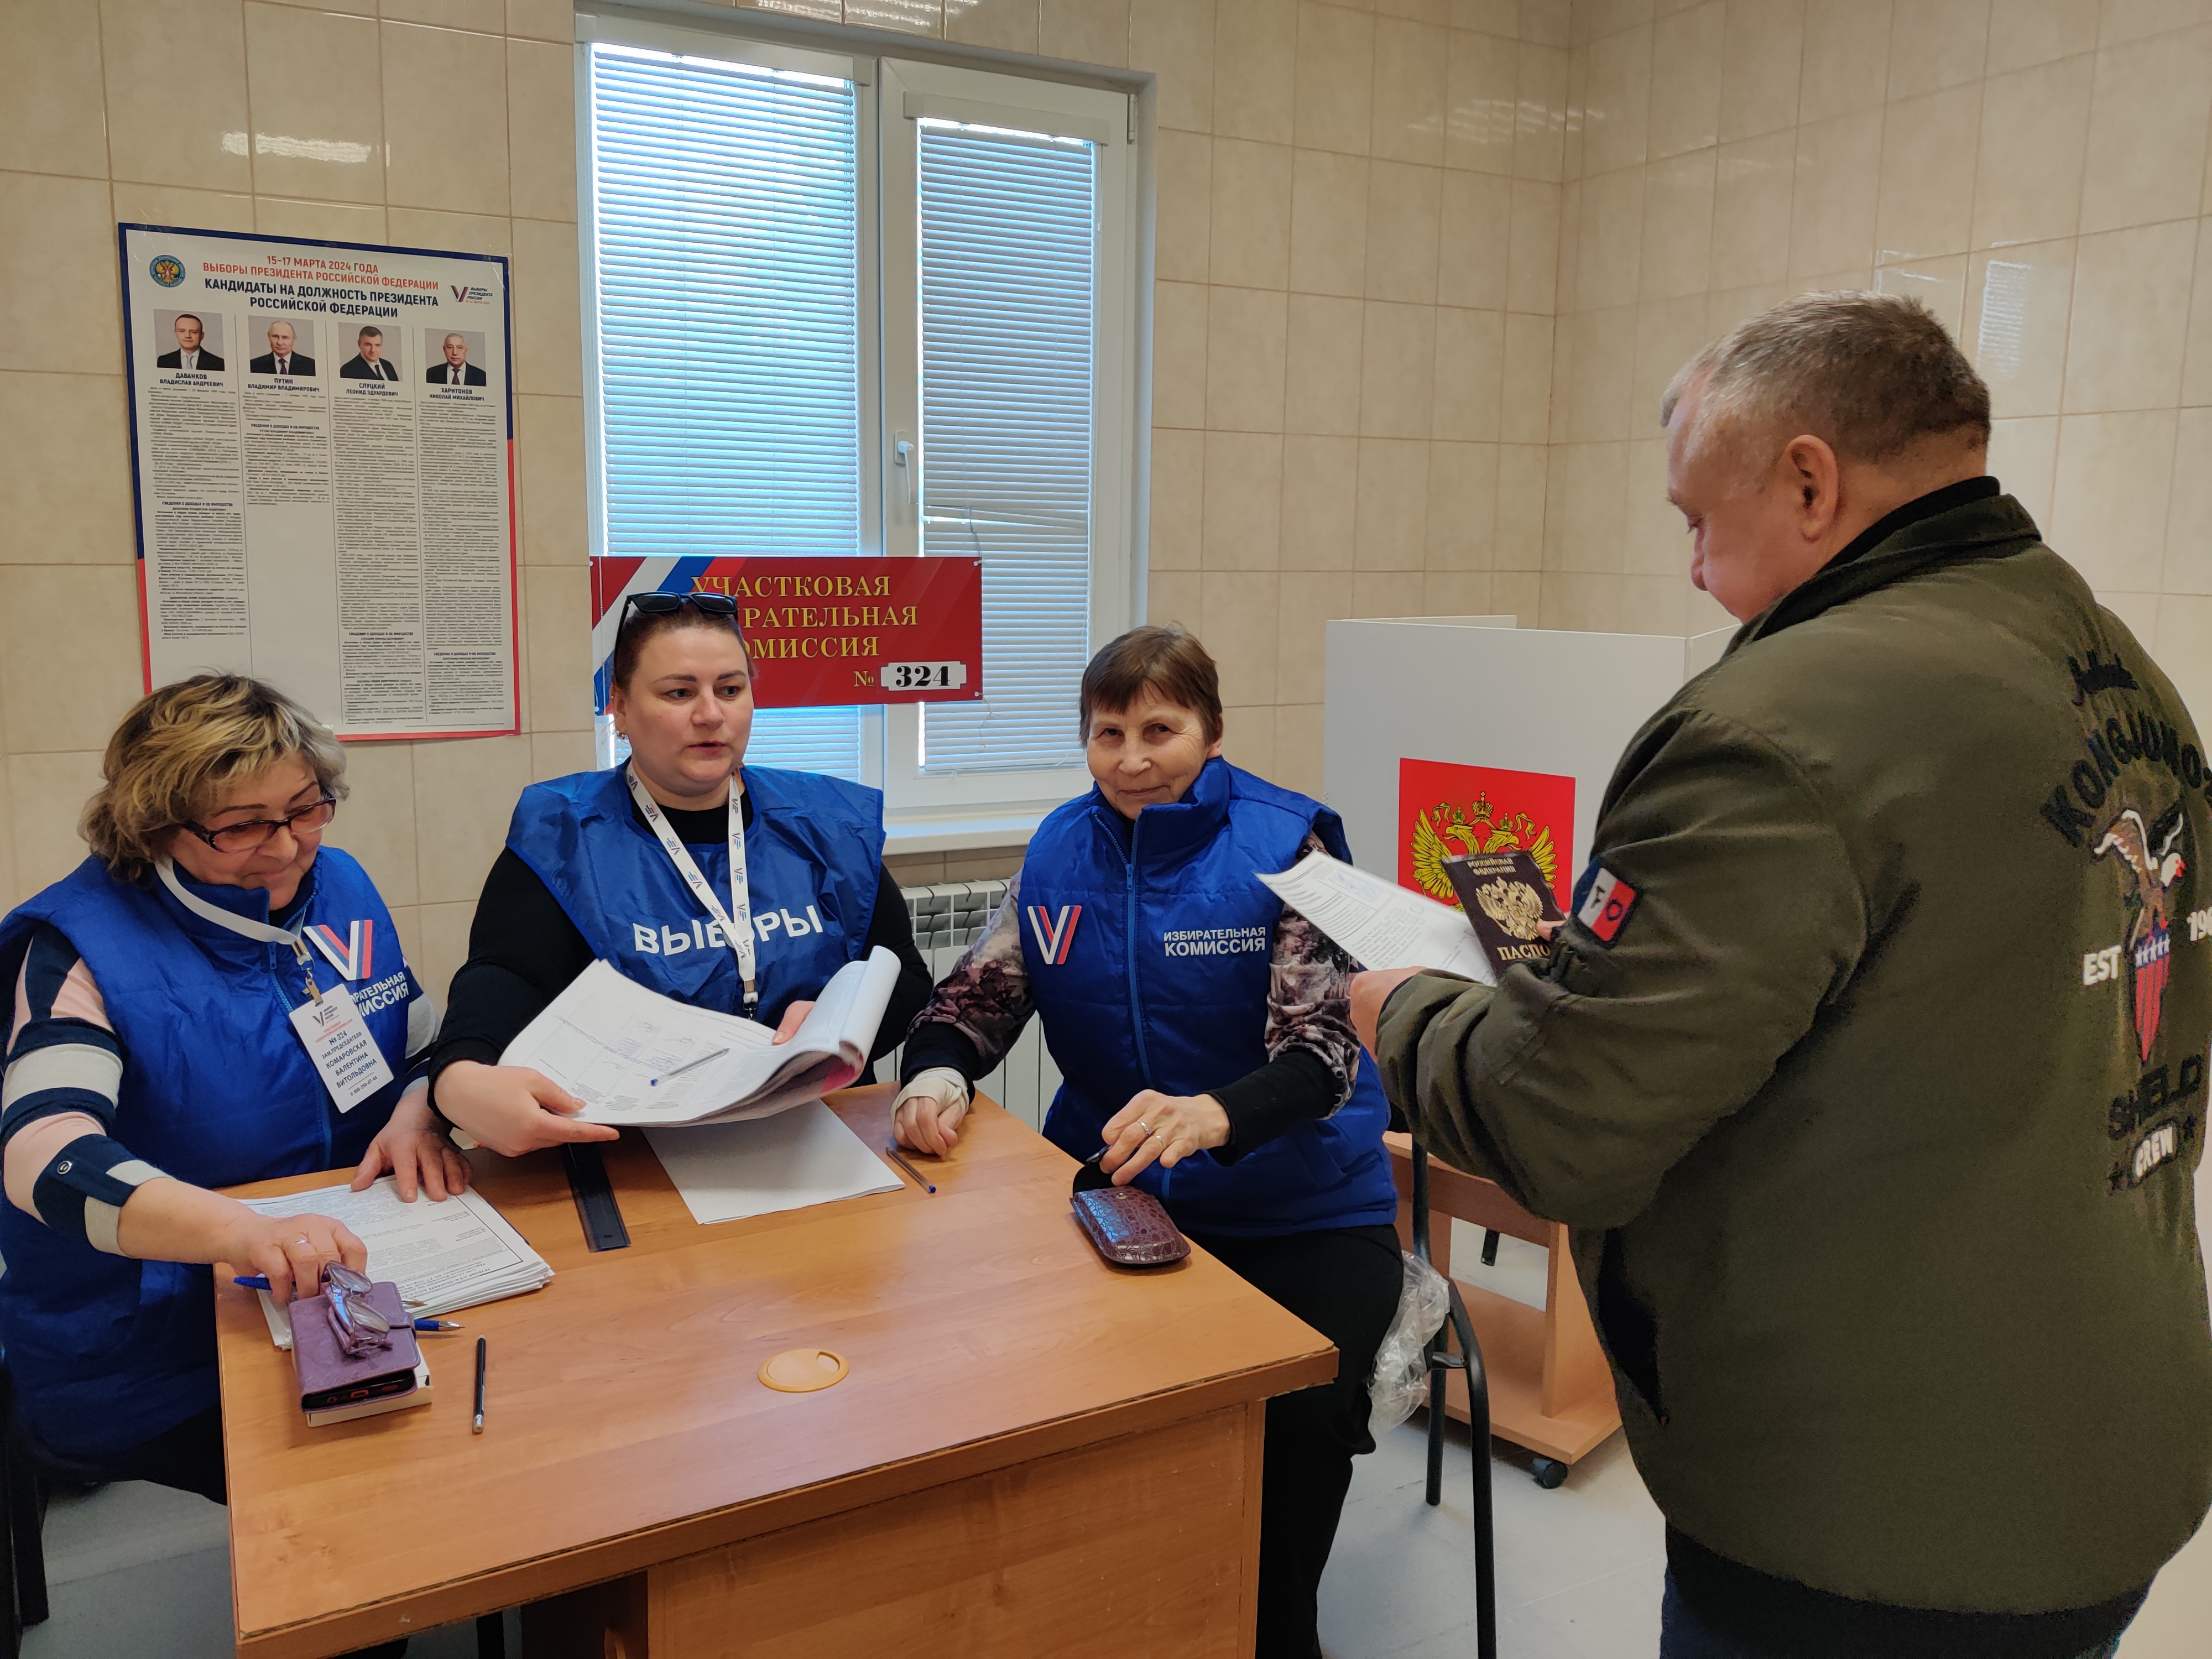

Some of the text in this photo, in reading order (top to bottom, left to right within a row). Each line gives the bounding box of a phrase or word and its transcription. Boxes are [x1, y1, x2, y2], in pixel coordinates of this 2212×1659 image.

[203, 262, 439, 290] ВЫБОРЫ ПРЕЗИДЕНТА РОССИЙСКОЙ ФЕДЕРАЦИИ
[294, 258, 326, 269] МАРТА
[328, 260, 351, 271] 2024
[354, 263, 379, 274] ГОДА
[205, 278, 439, 307] КАНДИДАТЫ НА ДОЛЖНОСТЬ ПРЕЗИДЕНТА
[250, 297, 398, 317] РОССИЙСКОЙ ФЕДЕРАЦИИ
[690, 576, 891, 598] УЧАСТКОВАЯ
[737, 606, 919, 629] РАТЕЛЬНАЯ
[895, 661, 950, 687] 324
[1164, 926, 1266, 942] ИЗБИРАТЕЛЬНАЯ
[1165, 938, 1266, 957] КОМИССИЯ
[2083, 945, 2122, 985] EST
[336, 1030, 348, 1040] 324
[326, 1039, 368, 1070] КОМАРОВСКАЯ
[335, 1052, 369, 1076] ВАЛЕНТИНА
[336, 1058, 377, 1088] ВИТОЛЬДОВНА
